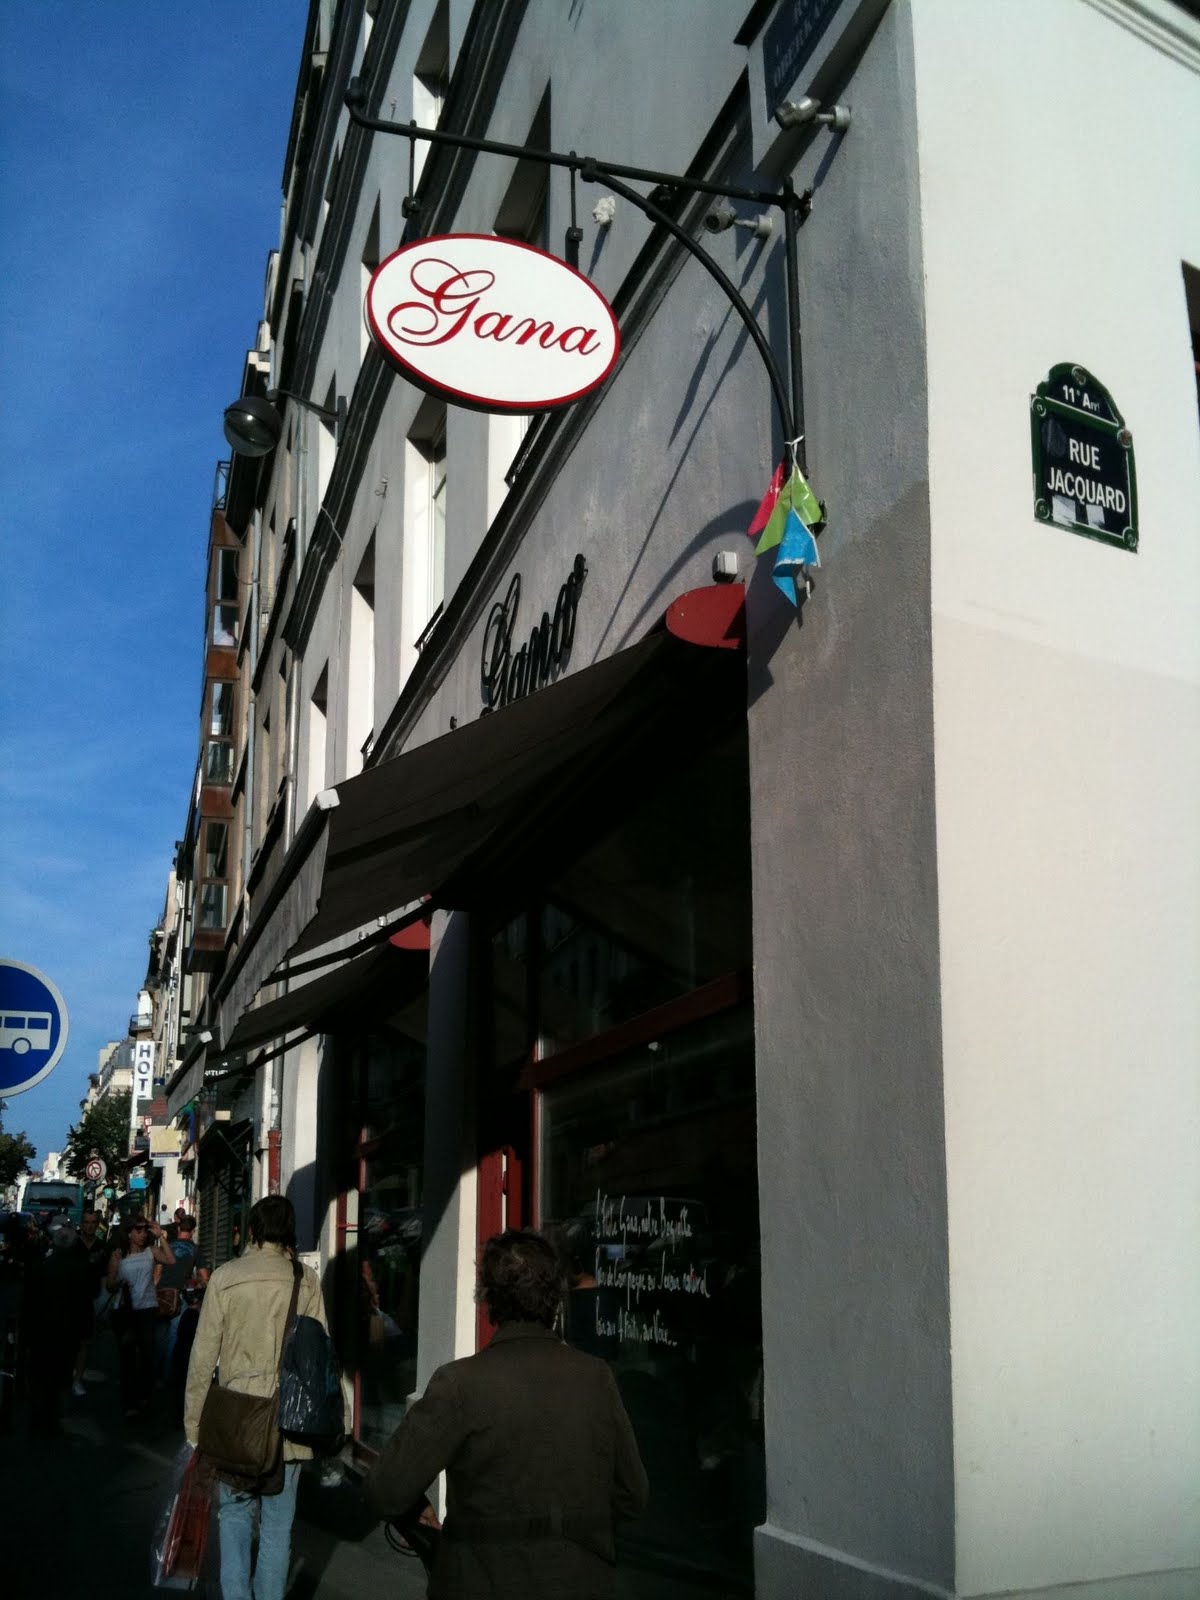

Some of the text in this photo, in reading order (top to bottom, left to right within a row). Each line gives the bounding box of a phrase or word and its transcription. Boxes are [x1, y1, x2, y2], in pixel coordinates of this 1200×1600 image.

[387, 258, 601, 356] Gana
[1068, 437, 1101, 470] RUE
[1047, 466, 1126, 513] JACQUARD
